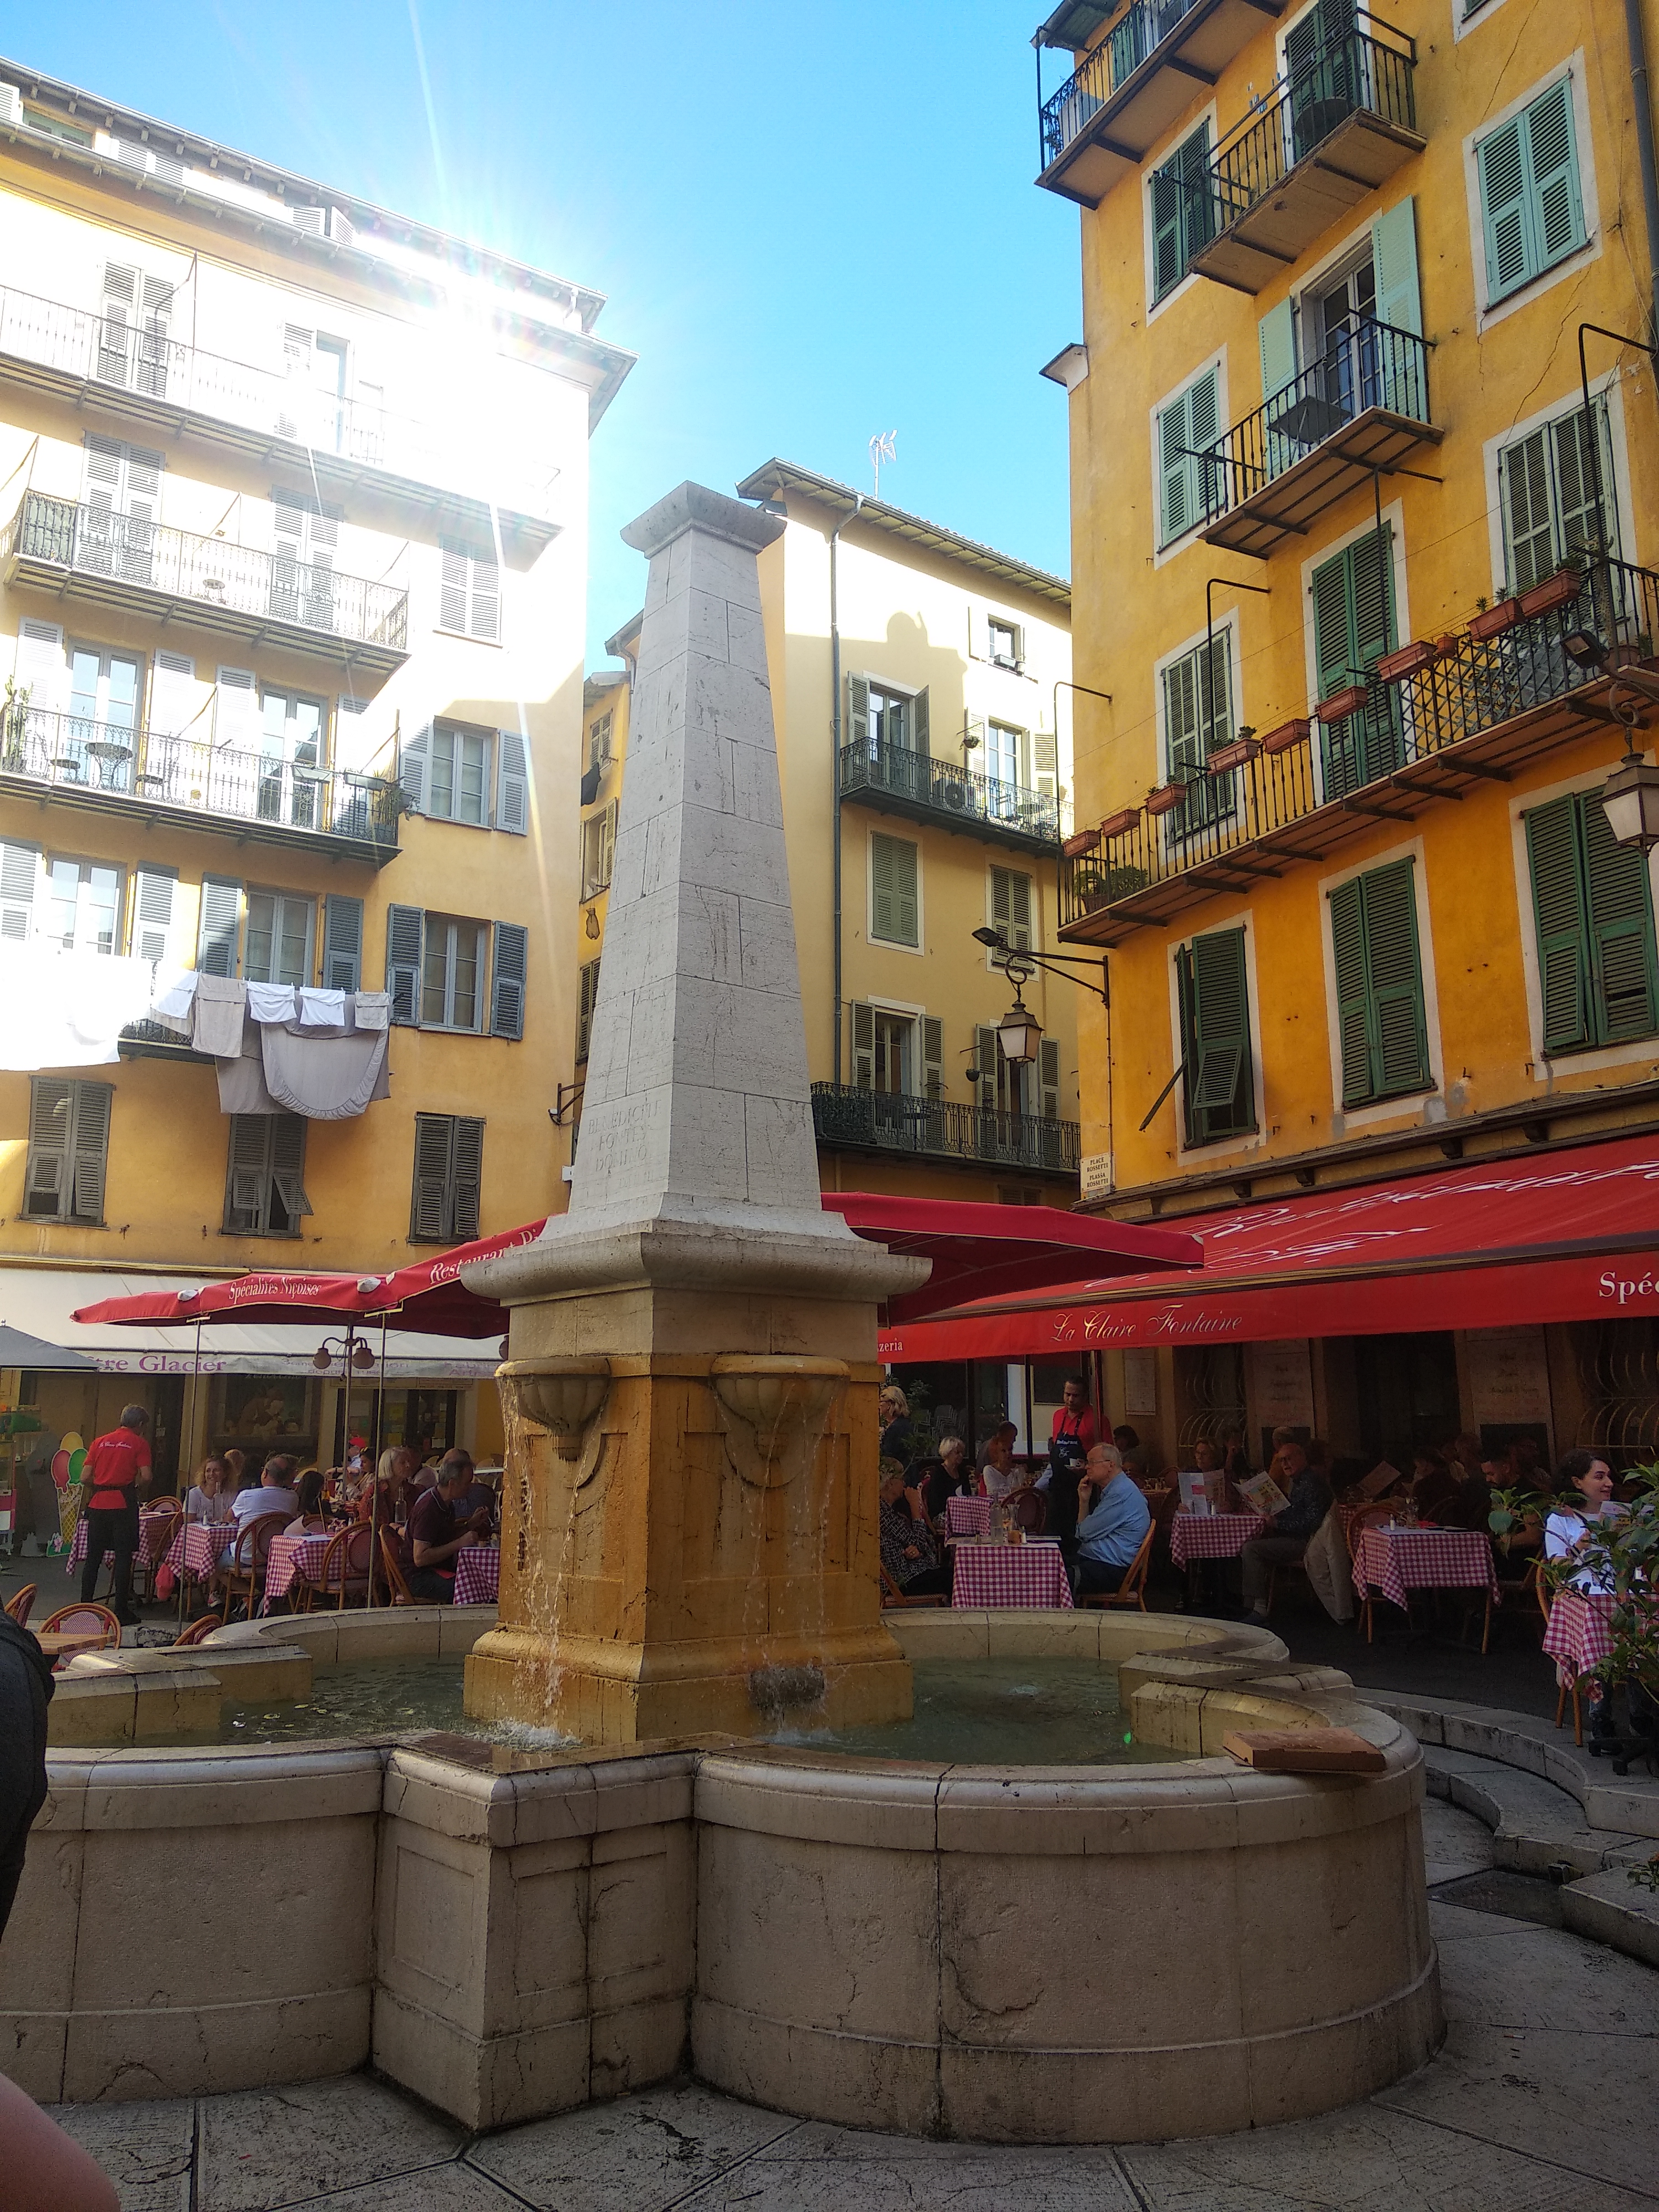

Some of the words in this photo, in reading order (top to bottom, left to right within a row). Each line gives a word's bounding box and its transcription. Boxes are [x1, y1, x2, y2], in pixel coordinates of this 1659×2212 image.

[1087, 1162, 1108, 1172] ROSSETTI
[1090, 1157, 1104, 1165] PLACE
[1089, 1172, 1105, 1181] PLASSA
[1087, 1178, 1108, 1188] ROSSETTI
[228, 1277, 278, 1305] Spécialités
[280, 1276, 322, 1299] Niçoises
[1050, 1312, 1076, 1342] La
[1084, 1310, 1136, 1340] Claire
[1145, 1303, 1243, 1336] Fontaine
[878, 1337, 903, 1352] zeria
[139, 1355, 227, 1372] Glacier
